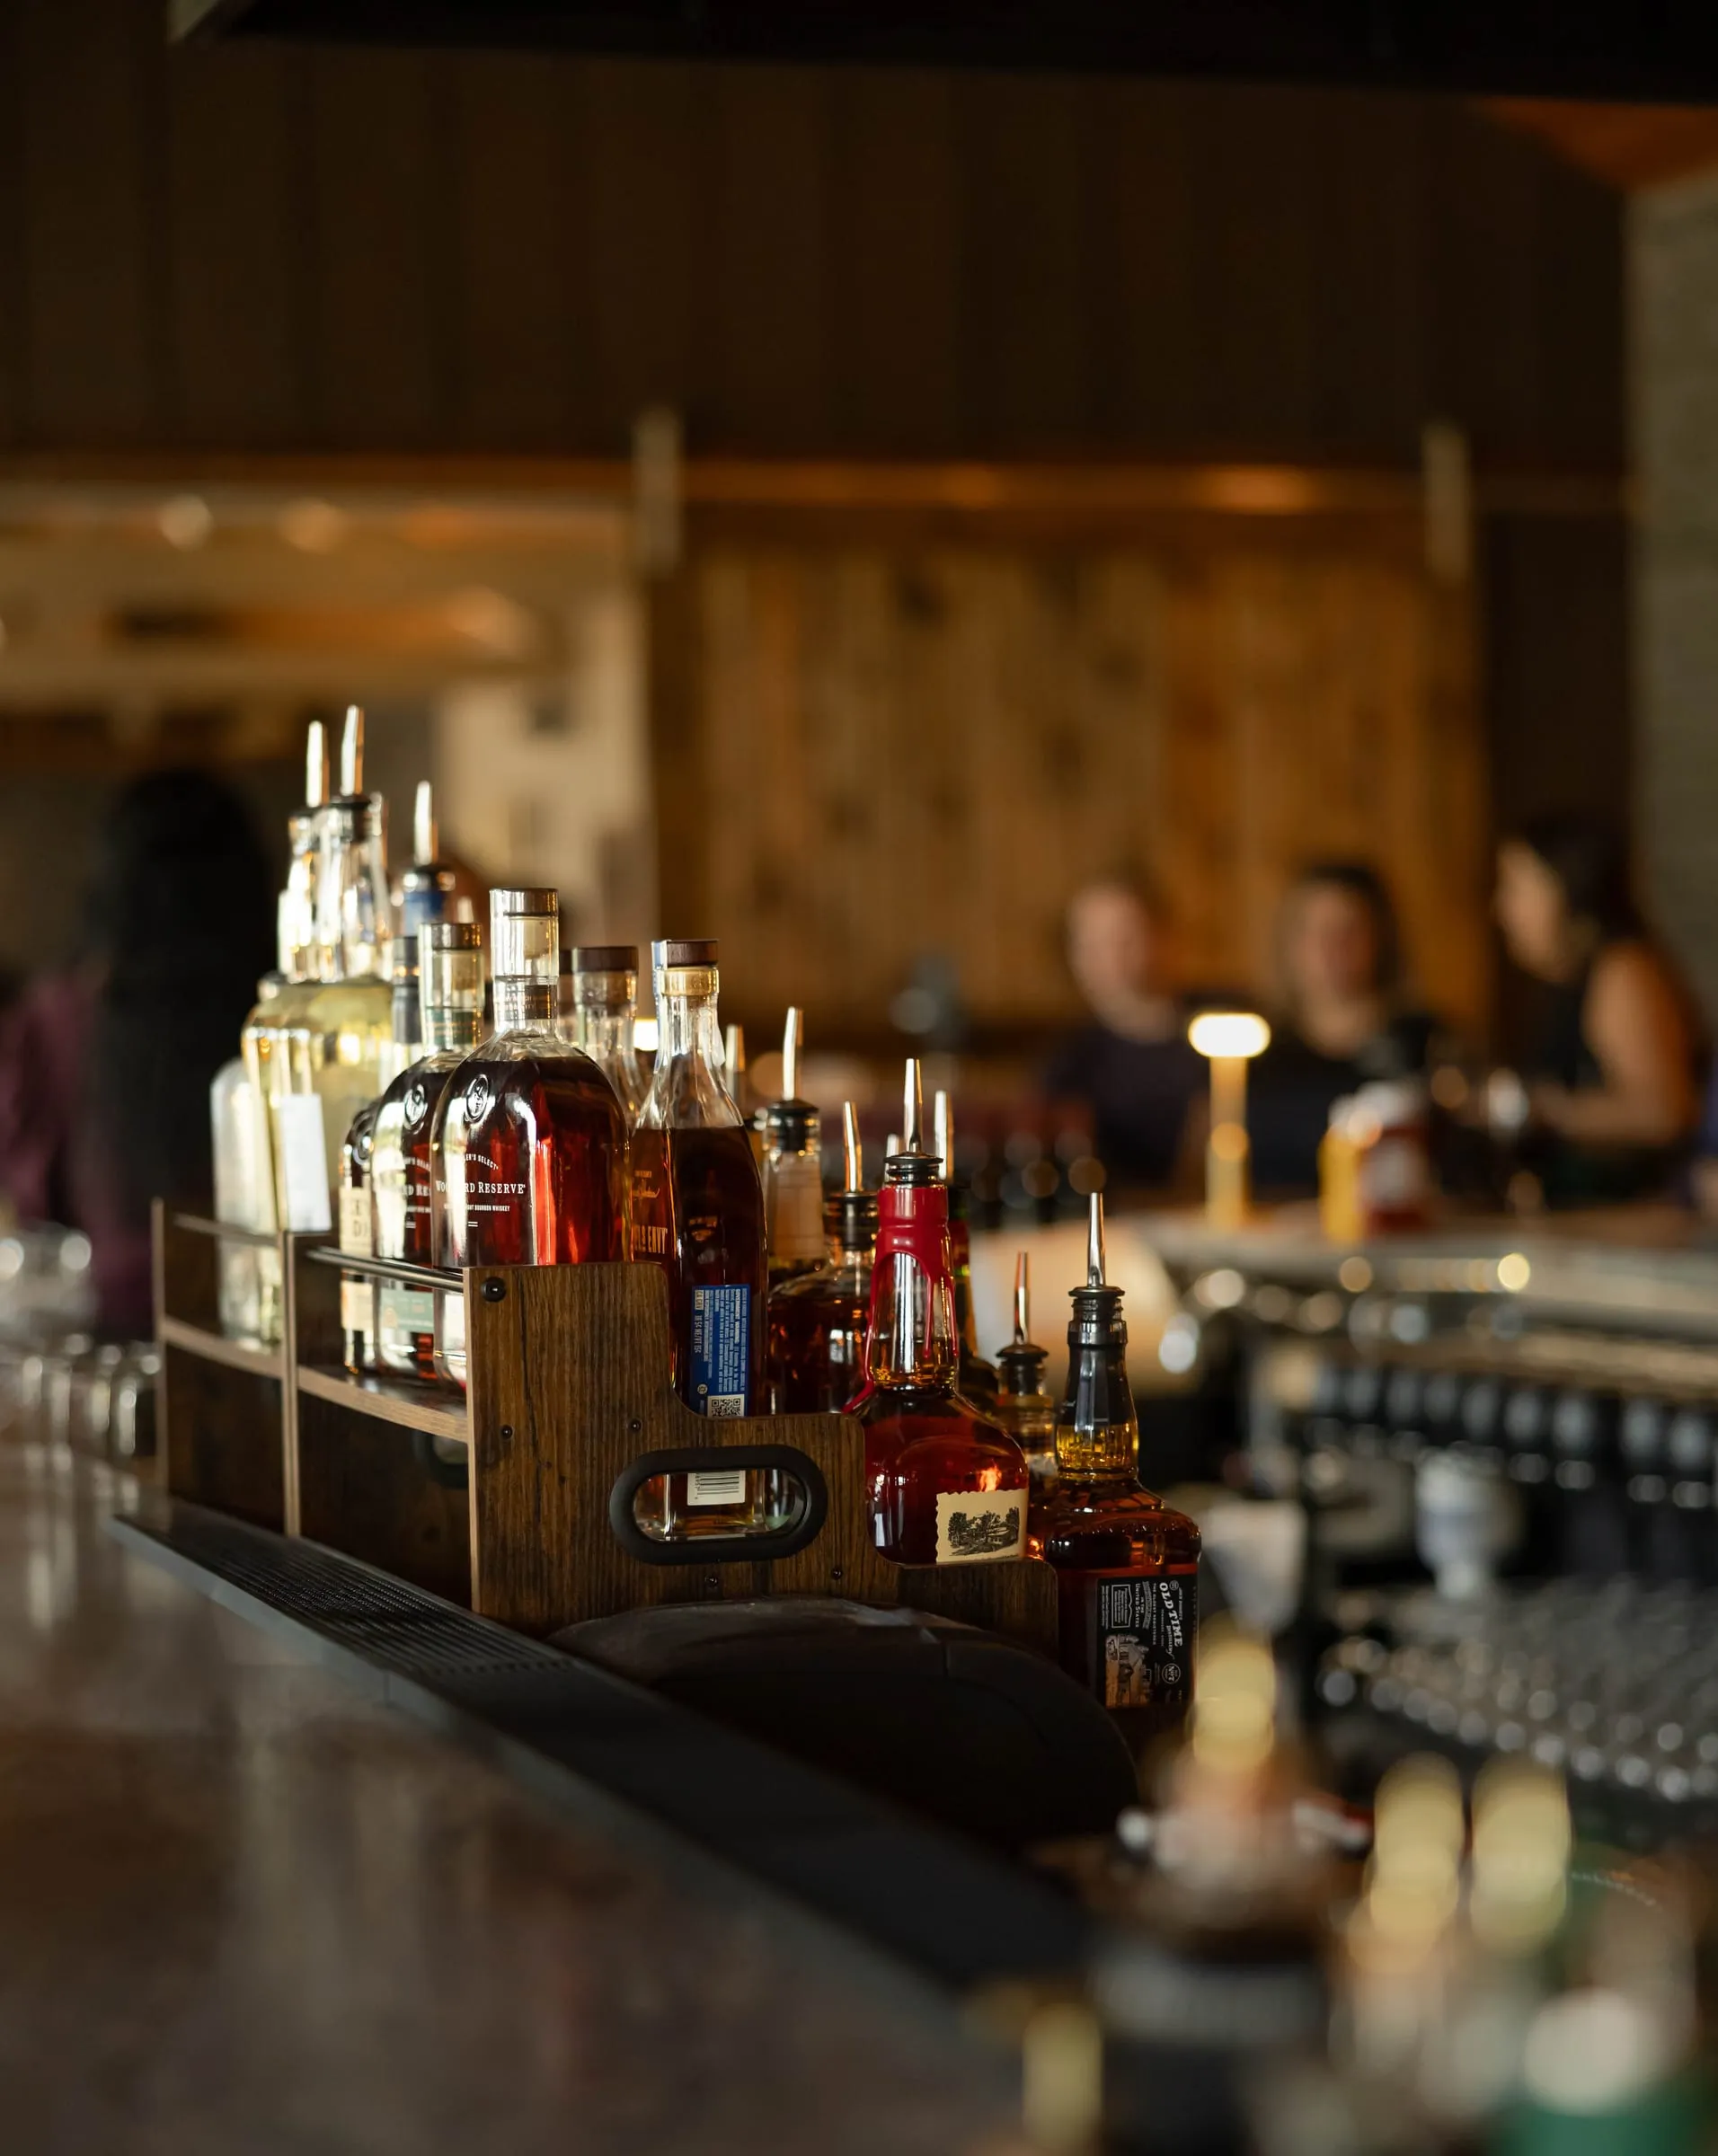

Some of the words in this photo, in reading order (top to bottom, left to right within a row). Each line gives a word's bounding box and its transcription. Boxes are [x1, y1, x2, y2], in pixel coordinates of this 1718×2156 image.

[478, 1181, 524, 1194] RESERVE
[1158, 1582, 1174, 1609] OLD
[1168, 1610, 1183, 1648] TIME
